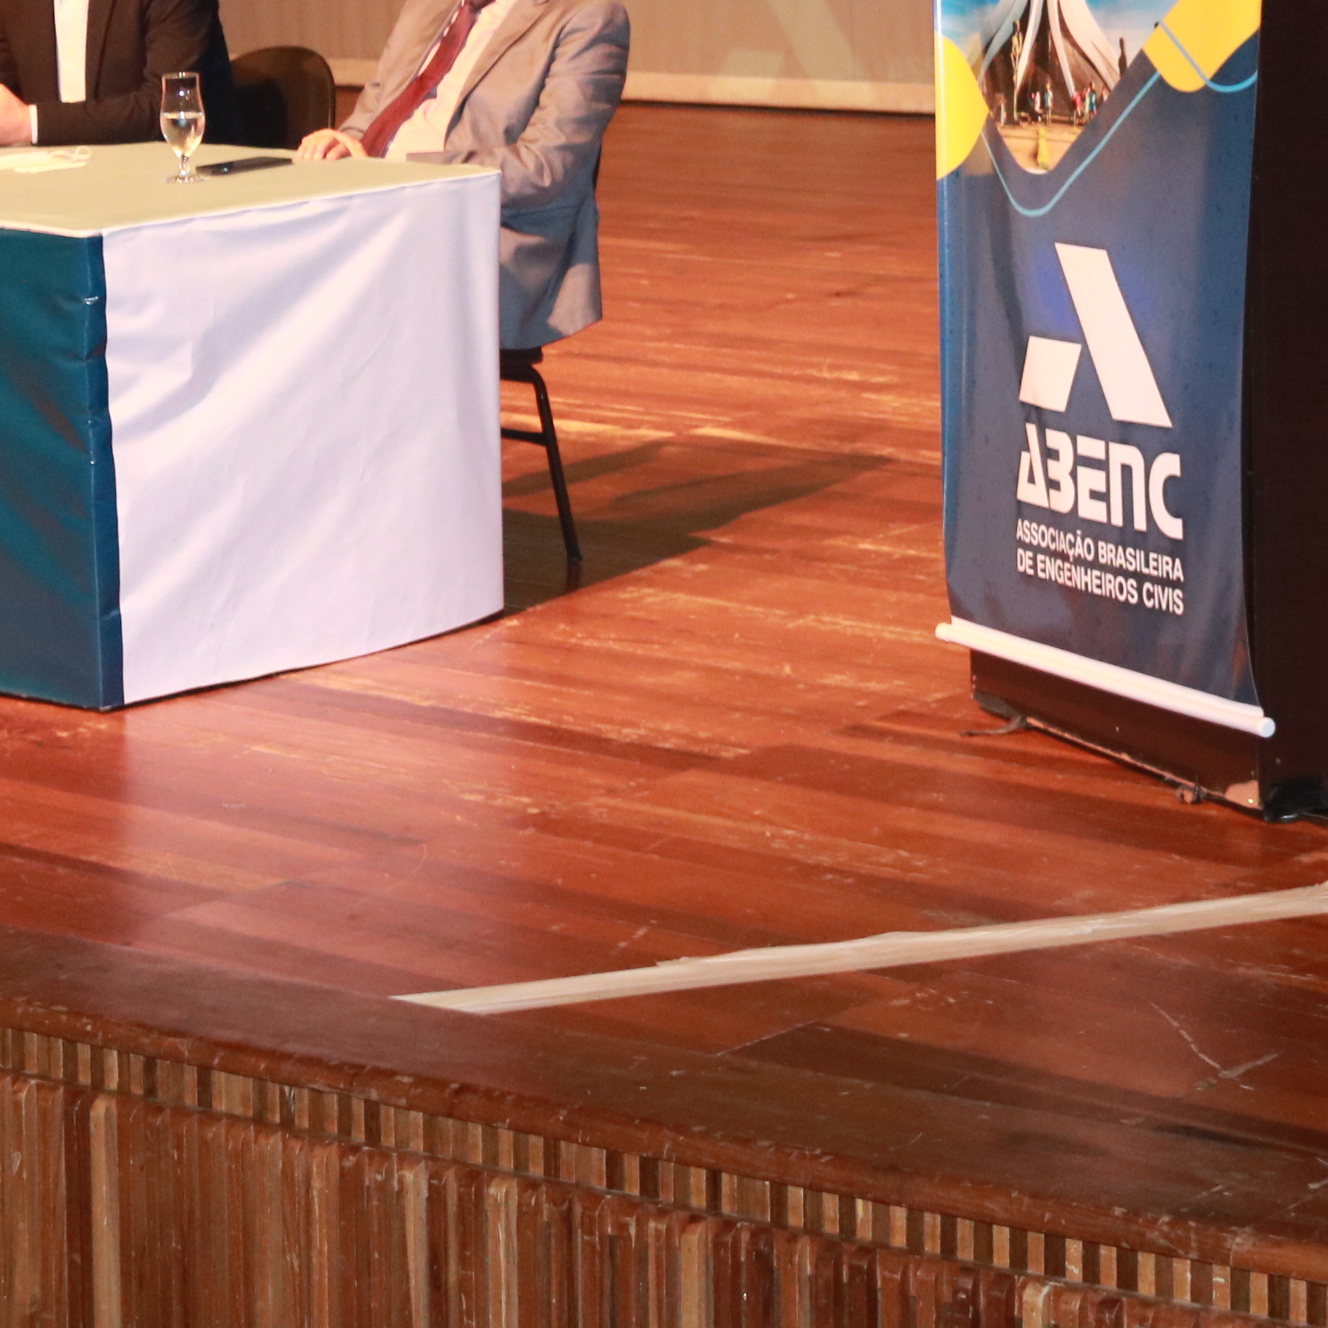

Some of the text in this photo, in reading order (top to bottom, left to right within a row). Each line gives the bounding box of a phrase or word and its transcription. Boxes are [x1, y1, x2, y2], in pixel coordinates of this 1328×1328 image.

[1016, 422, 1184, 541] ABENC
[1016, 518, 1184, 582] ASSOCIAÇÃO BRASILEIRA
[1017, 548, 1184, 616] DE ENGENHEIROS CIVIS
